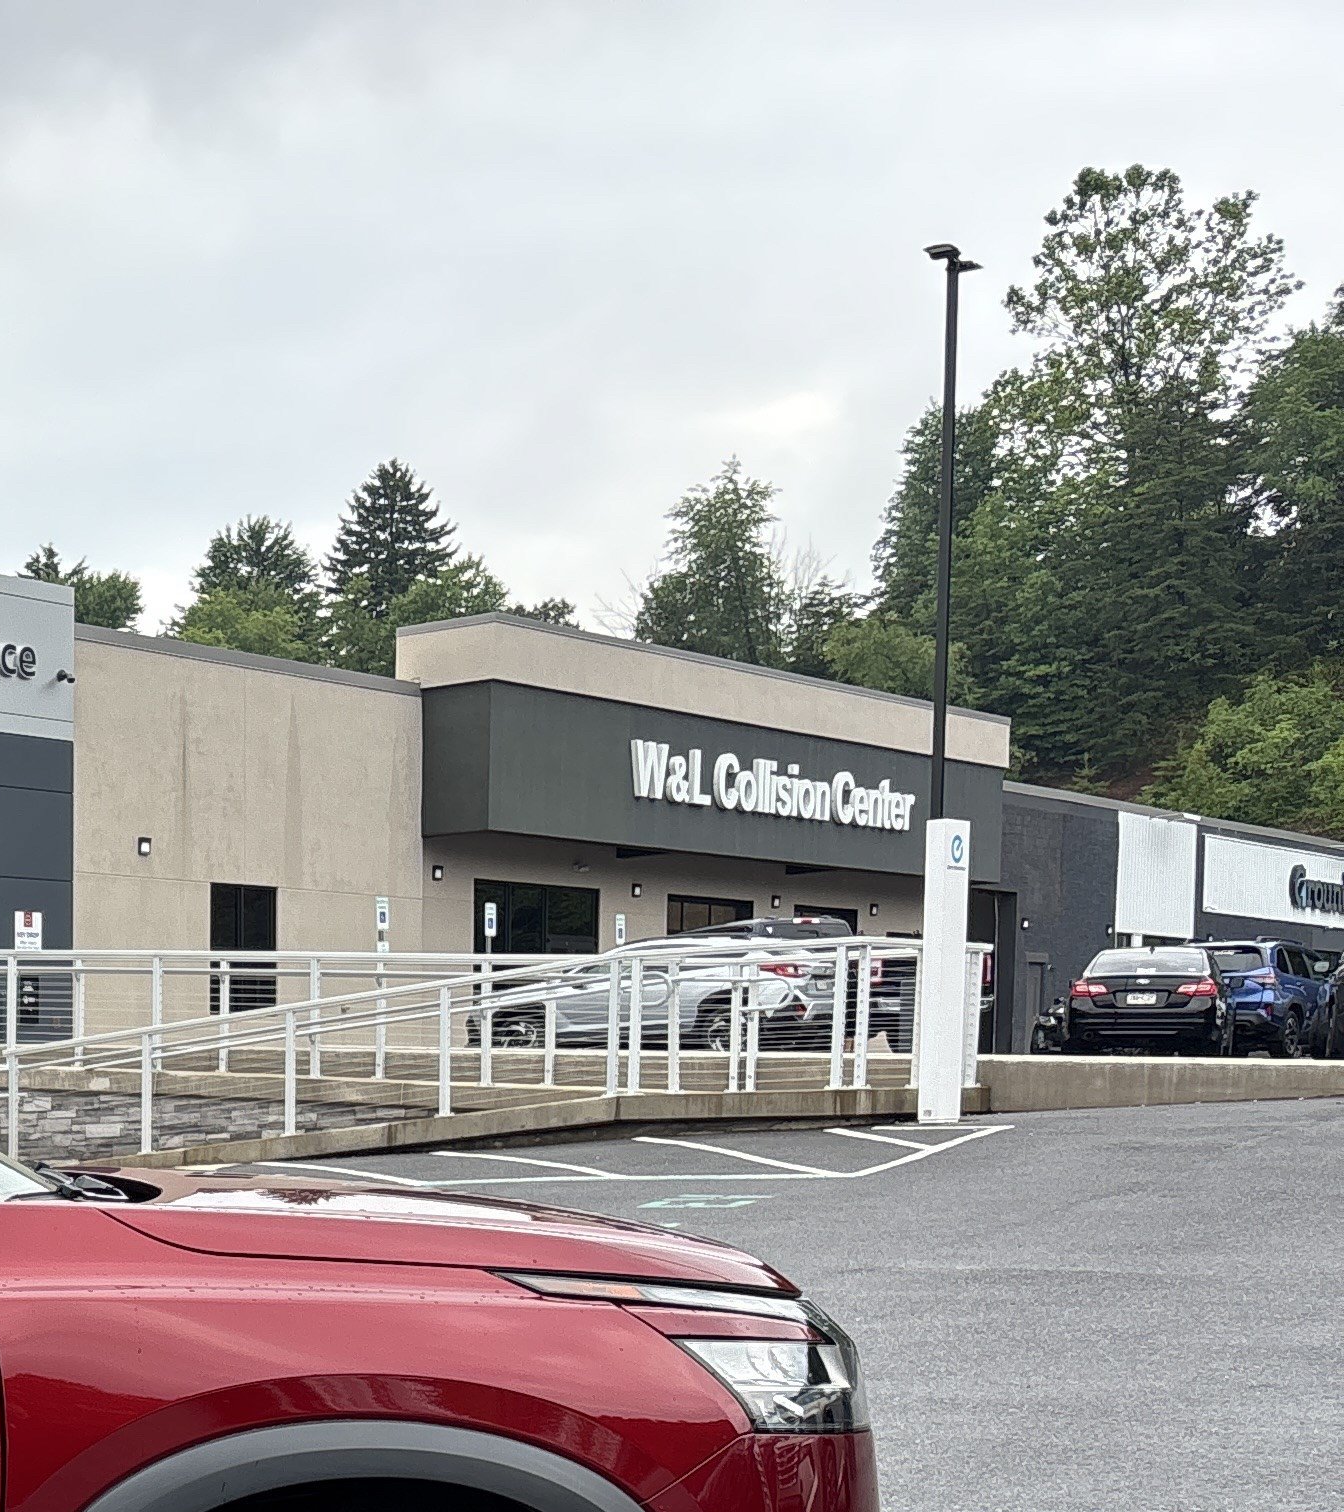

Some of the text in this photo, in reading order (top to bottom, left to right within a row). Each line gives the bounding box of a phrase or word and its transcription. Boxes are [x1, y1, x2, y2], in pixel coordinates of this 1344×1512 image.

[631, 739, 916, 831] W&L Collision Center
[1289, 864, 1344, 912] Groun
